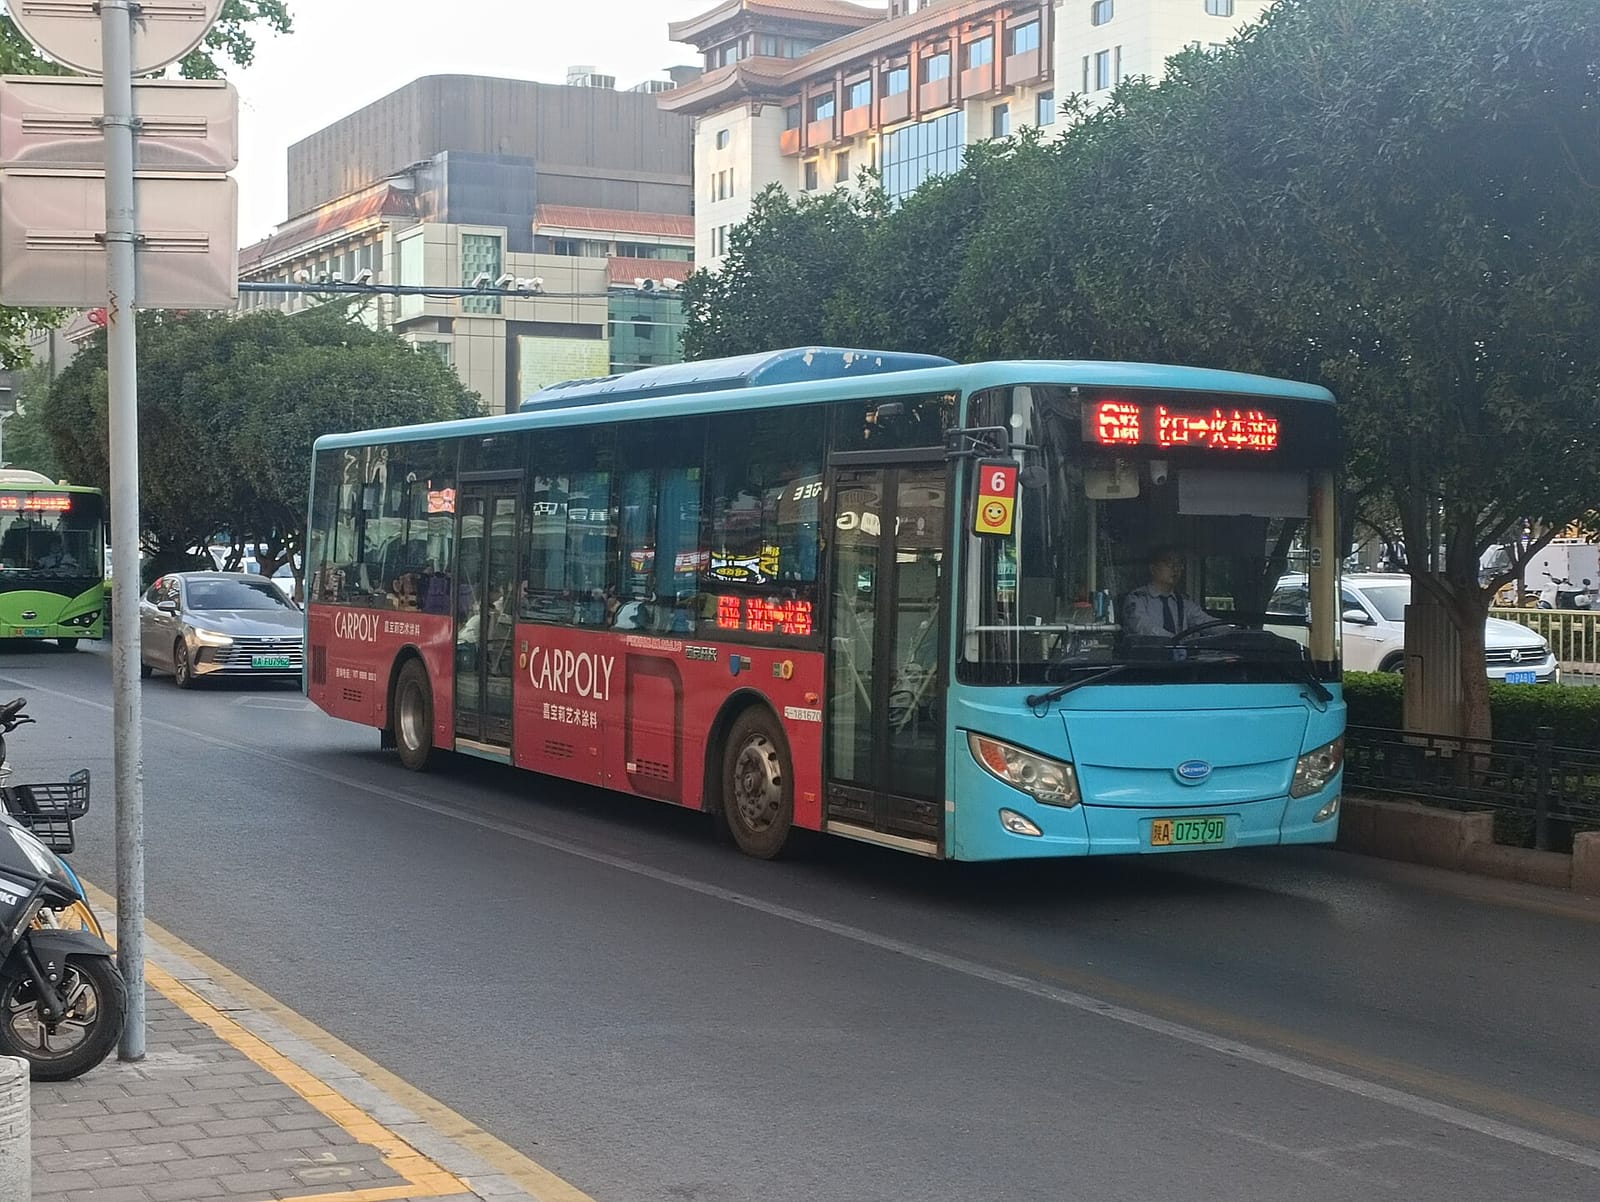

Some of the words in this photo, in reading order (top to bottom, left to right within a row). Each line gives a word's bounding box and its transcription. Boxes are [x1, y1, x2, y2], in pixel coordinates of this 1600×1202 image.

[991, 471, 1006, 492] 6
[334, 611, 380, 642] CARPOLY
[529, 646, 615, 701] CARPOLY
[543, 702, 598, 729] 嘉宝莉艺术涂料
